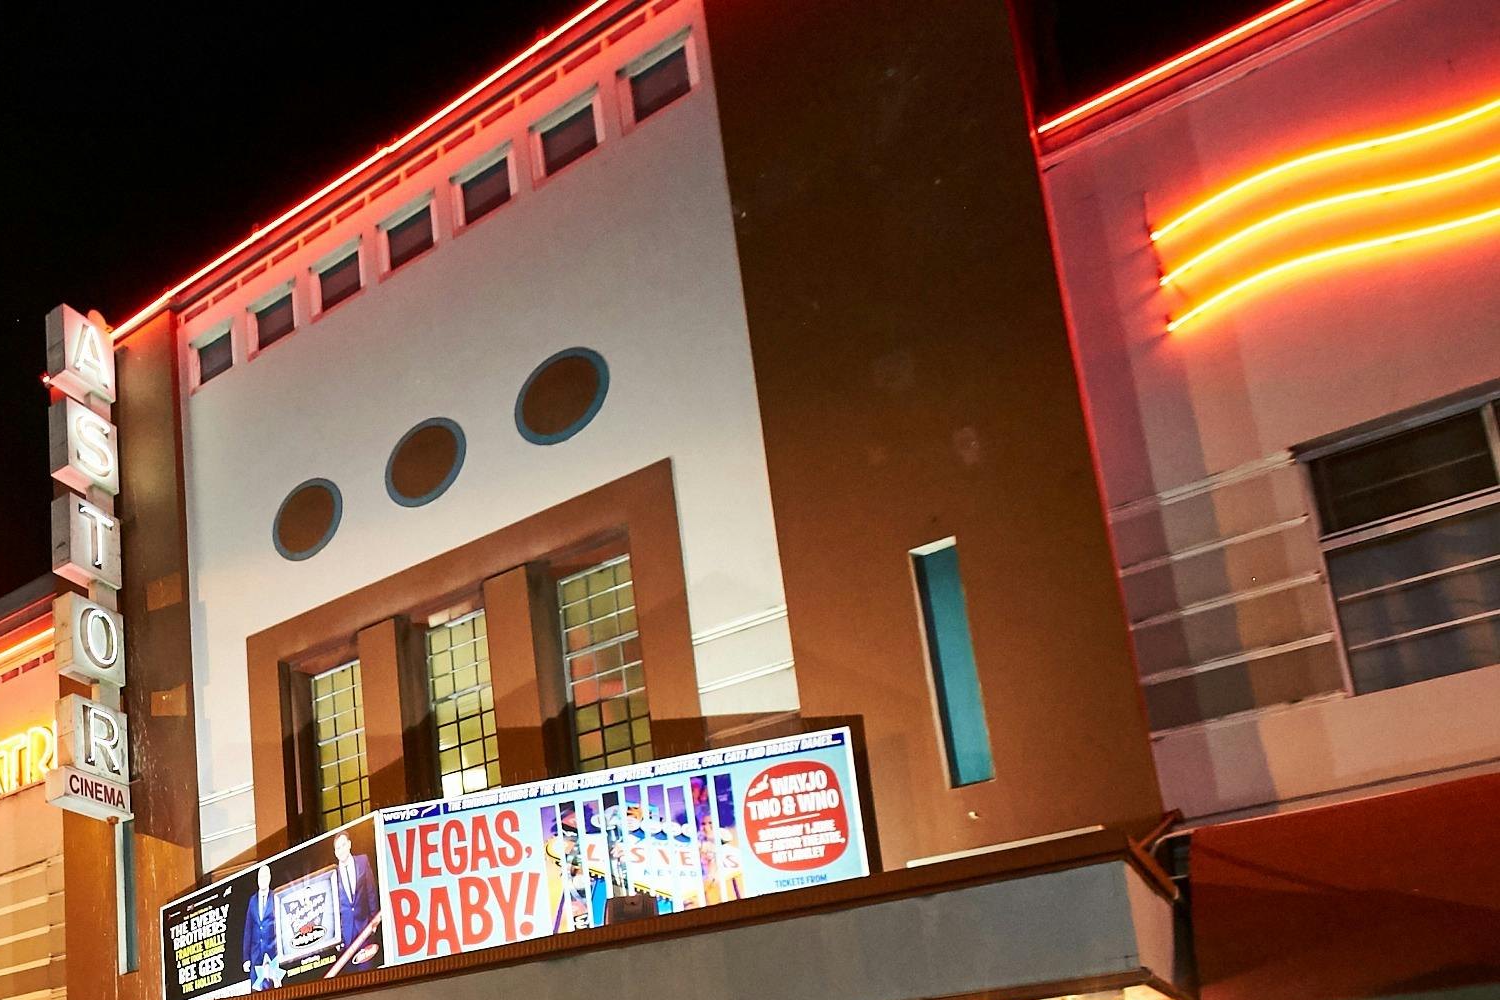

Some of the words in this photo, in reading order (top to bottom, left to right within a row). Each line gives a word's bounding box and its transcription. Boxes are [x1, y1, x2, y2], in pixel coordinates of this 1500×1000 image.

[74, 322, 122, 776] ASTOR
[69, 774, 125, 809] CINEMA
[771, 769, 827, 796] WAYJO
[387, 809, 533, 884] VEGAS,
[170, 921, 188, 939] THE
[190, 904, 229, 930] EVERLY
[389, 871, 540, 957] BABY!
[173, 919, 227, 950] BROTHERS
[179, 964, 197, 984] BEE
[199, 954, 224, 976] GEES
